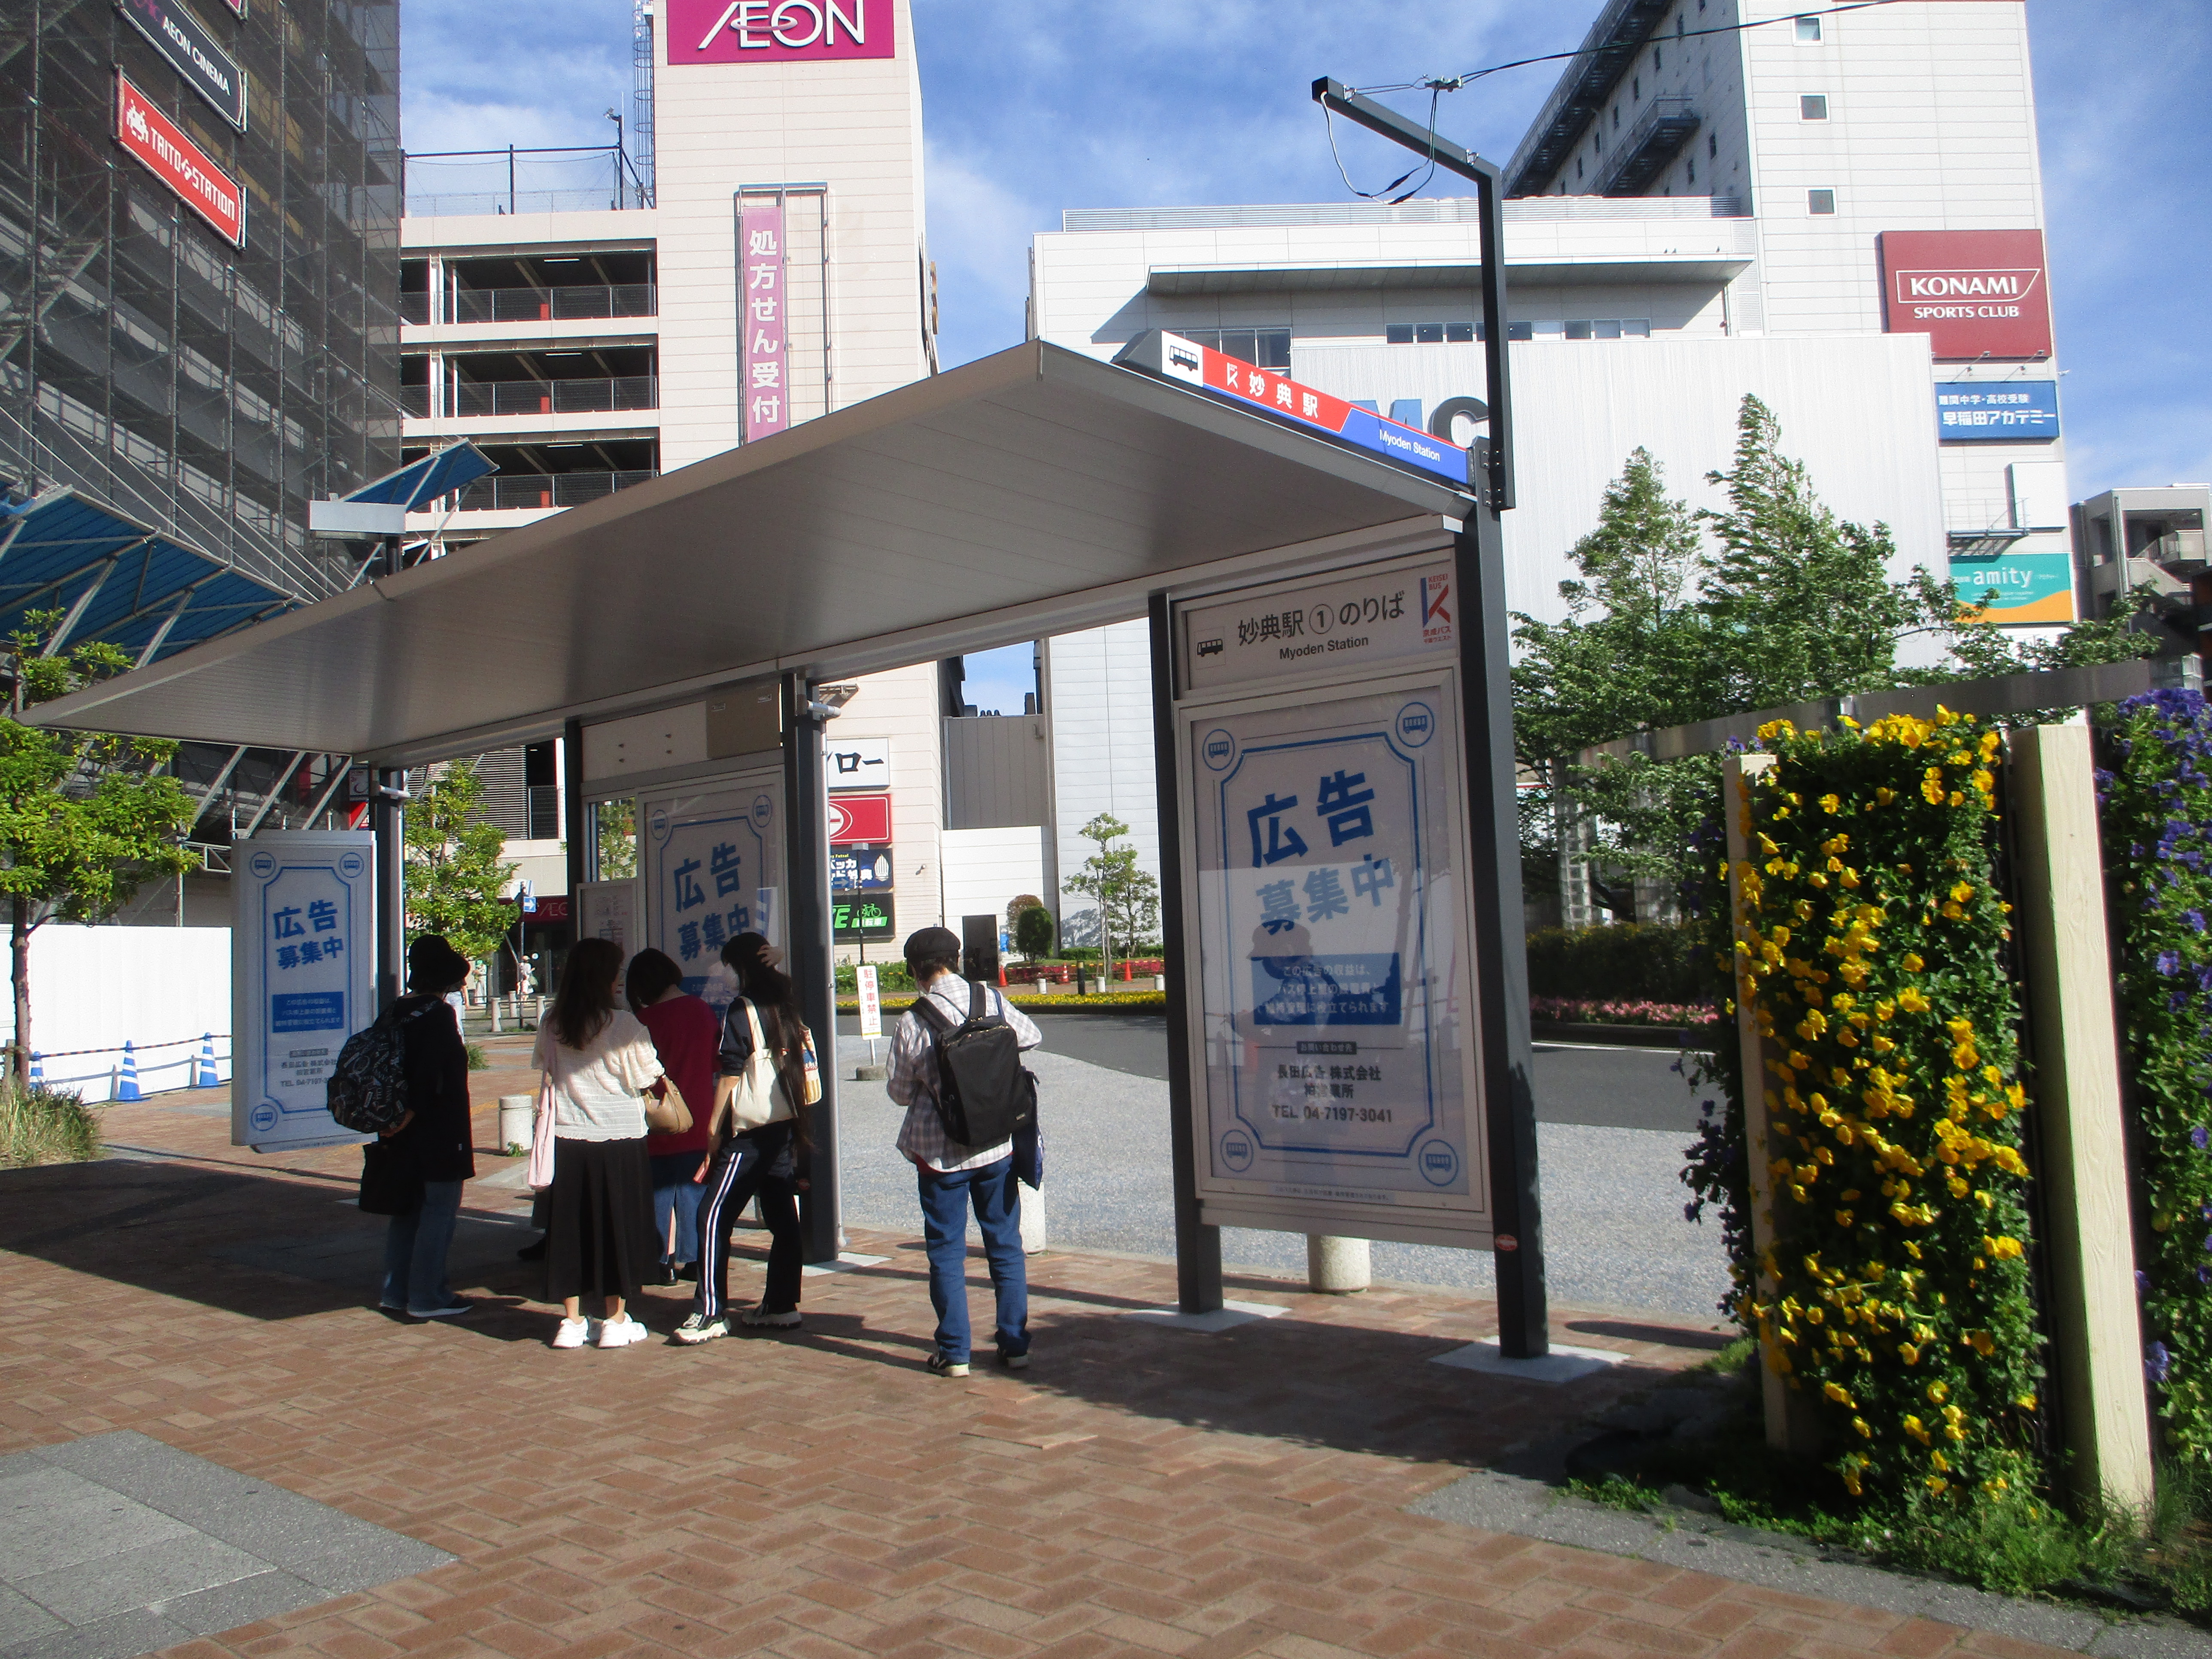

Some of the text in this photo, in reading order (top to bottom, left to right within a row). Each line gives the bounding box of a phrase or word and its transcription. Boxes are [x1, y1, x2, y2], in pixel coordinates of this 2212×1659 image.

[698, 0, 865, 49] AEON
[162, 15, 231, 96] AEON CINEMA
[151, 127, 235, 222] TAITO STATION
[1910, 276, 2018, 296] KONAMI
[749, 230, 780, 424] 処方せん受付
[1914, 306, 2019, 319] SPORTS CLUB
[1249, 371, 1319, 419] 妙典駅
[1942, 409, 2056, 426] 早稲田アカデミー
[1379, 429, 1440, 462] Myoden Station
[1428, 574, 1448, 583] KEISEI
[1429, 582, 1442, 590] BUS
[1973, 567, 2033, 588] amity
[1279, 635, 1369, 660] Myoden Station
[827, 751, 884, 774] ロー
[1247, 769, 1375, 869] 広告
[674, 842, 741, 913] 広告
[1255, 854, 1395, 936] 募集中
[273, 899, 338, 940] 広告
[678, 903, 750, 962] 募集中
[833, 908, 851, 929] E
[276, 936, 344, 970] 募集中
[863, 969, 878, 1026] 駐停車禁止
[1330, 1065, 1382, 1081] 株式会社
[1272, 1104, 1392, 1123] TEL 04-7197-3041
